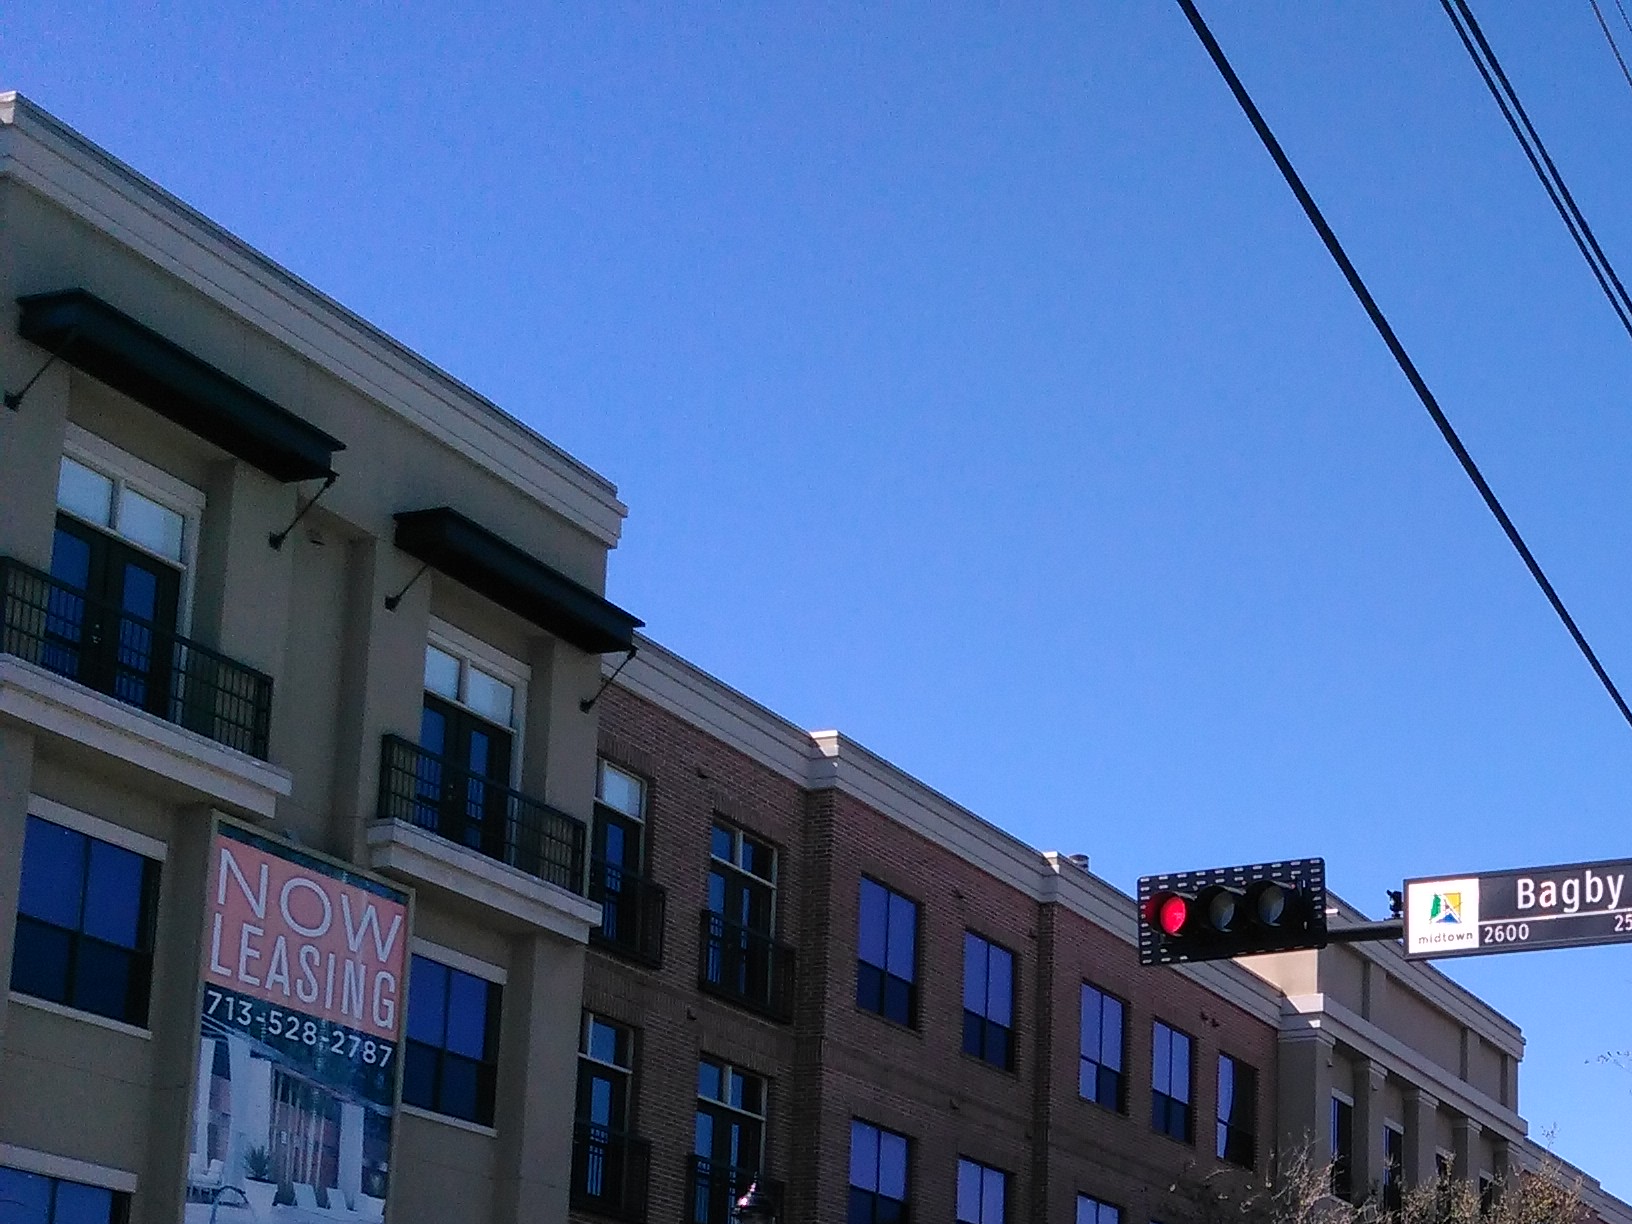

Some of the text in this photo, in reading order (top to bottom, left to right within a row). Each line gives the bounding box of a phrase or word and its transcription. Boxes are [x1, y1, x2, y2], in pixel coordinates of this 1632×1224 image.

[217, 848, 402, 963] NOW
[1516, 870, 1625, 913] Bagby
[1418, 931, 1474, 945] midtown
[1484, 924, 1530, 944] 2600
[210, 912, 396, 1030] LEASING
[206, 990, 393, 1068] 713-528-2787
